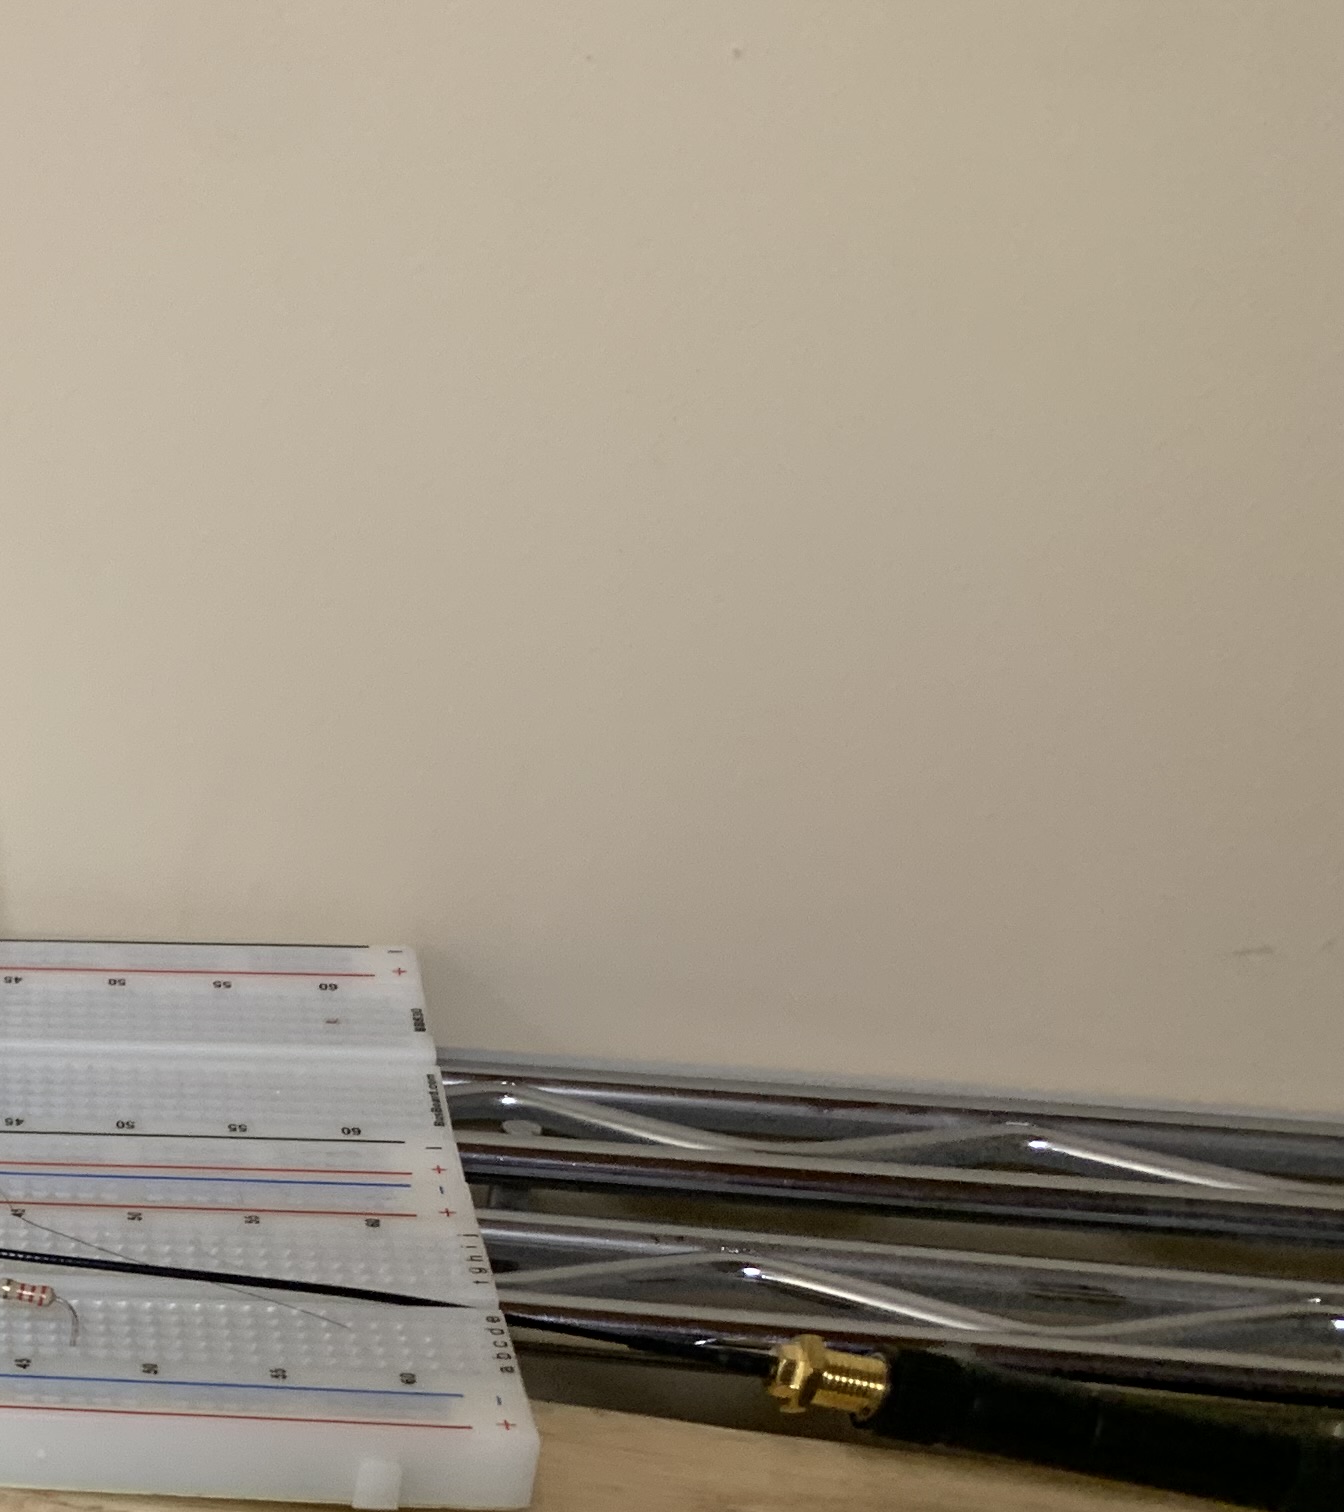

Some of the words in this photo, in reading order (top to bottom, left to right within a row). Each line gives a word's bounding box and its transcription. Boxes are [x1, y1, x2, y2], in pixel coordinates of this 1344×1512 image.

[3, 975, 23, 985] 45
[107, 978, 126, 987] 50
[212, 980, 232, 989] 55
[318, 983, 339, 992] 60
[426, 1072, 445, 1128] BusBoard.com
[4, 1117, 25, 1127] 45
[115, 1119, 136, 1130] 50
[227, 1123, 248, 1133] 55
[340, 1126, 362, 1136] 60
[14, 1357, 32, 1370] 45
